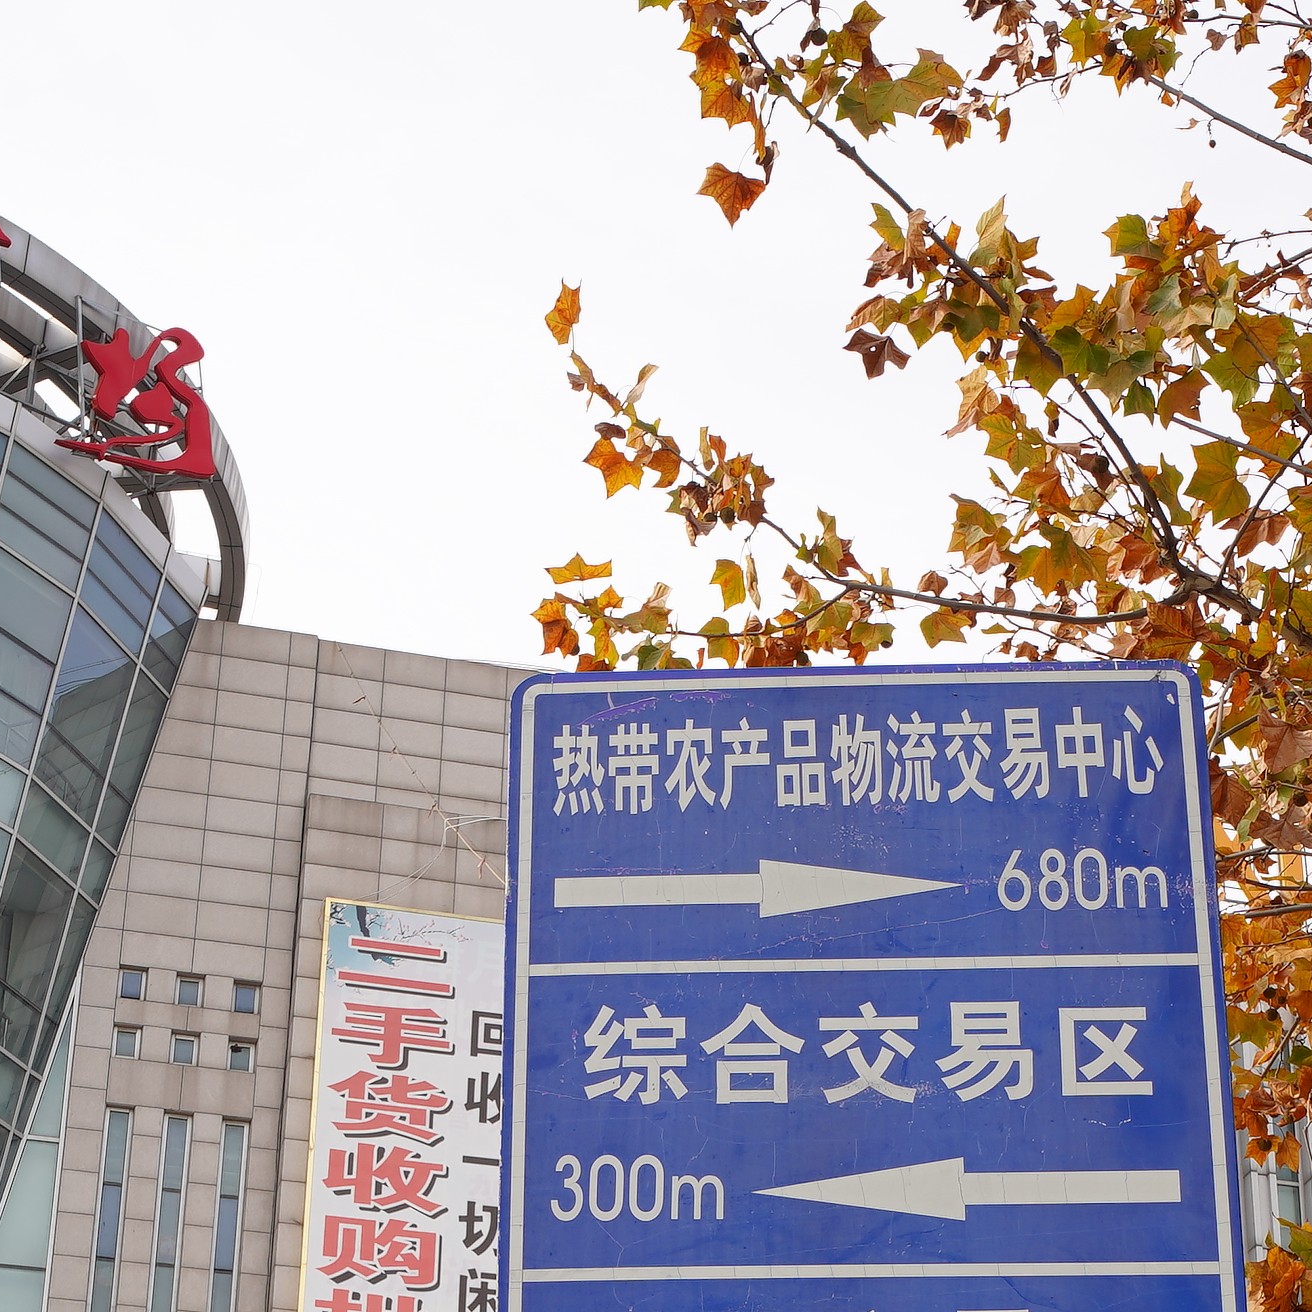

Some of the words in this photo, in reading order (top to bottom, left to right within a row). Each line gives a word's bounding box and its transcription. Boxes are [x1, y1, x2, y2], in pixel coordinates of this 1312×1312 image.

[552, 707, 1163, 816] 热带农产品物流交易中心
[997, 848, 1167, 912] 680m
[584, 1001, 1154, 1104] 综合交易区
[550, 1154, 725, 1221] 300m
